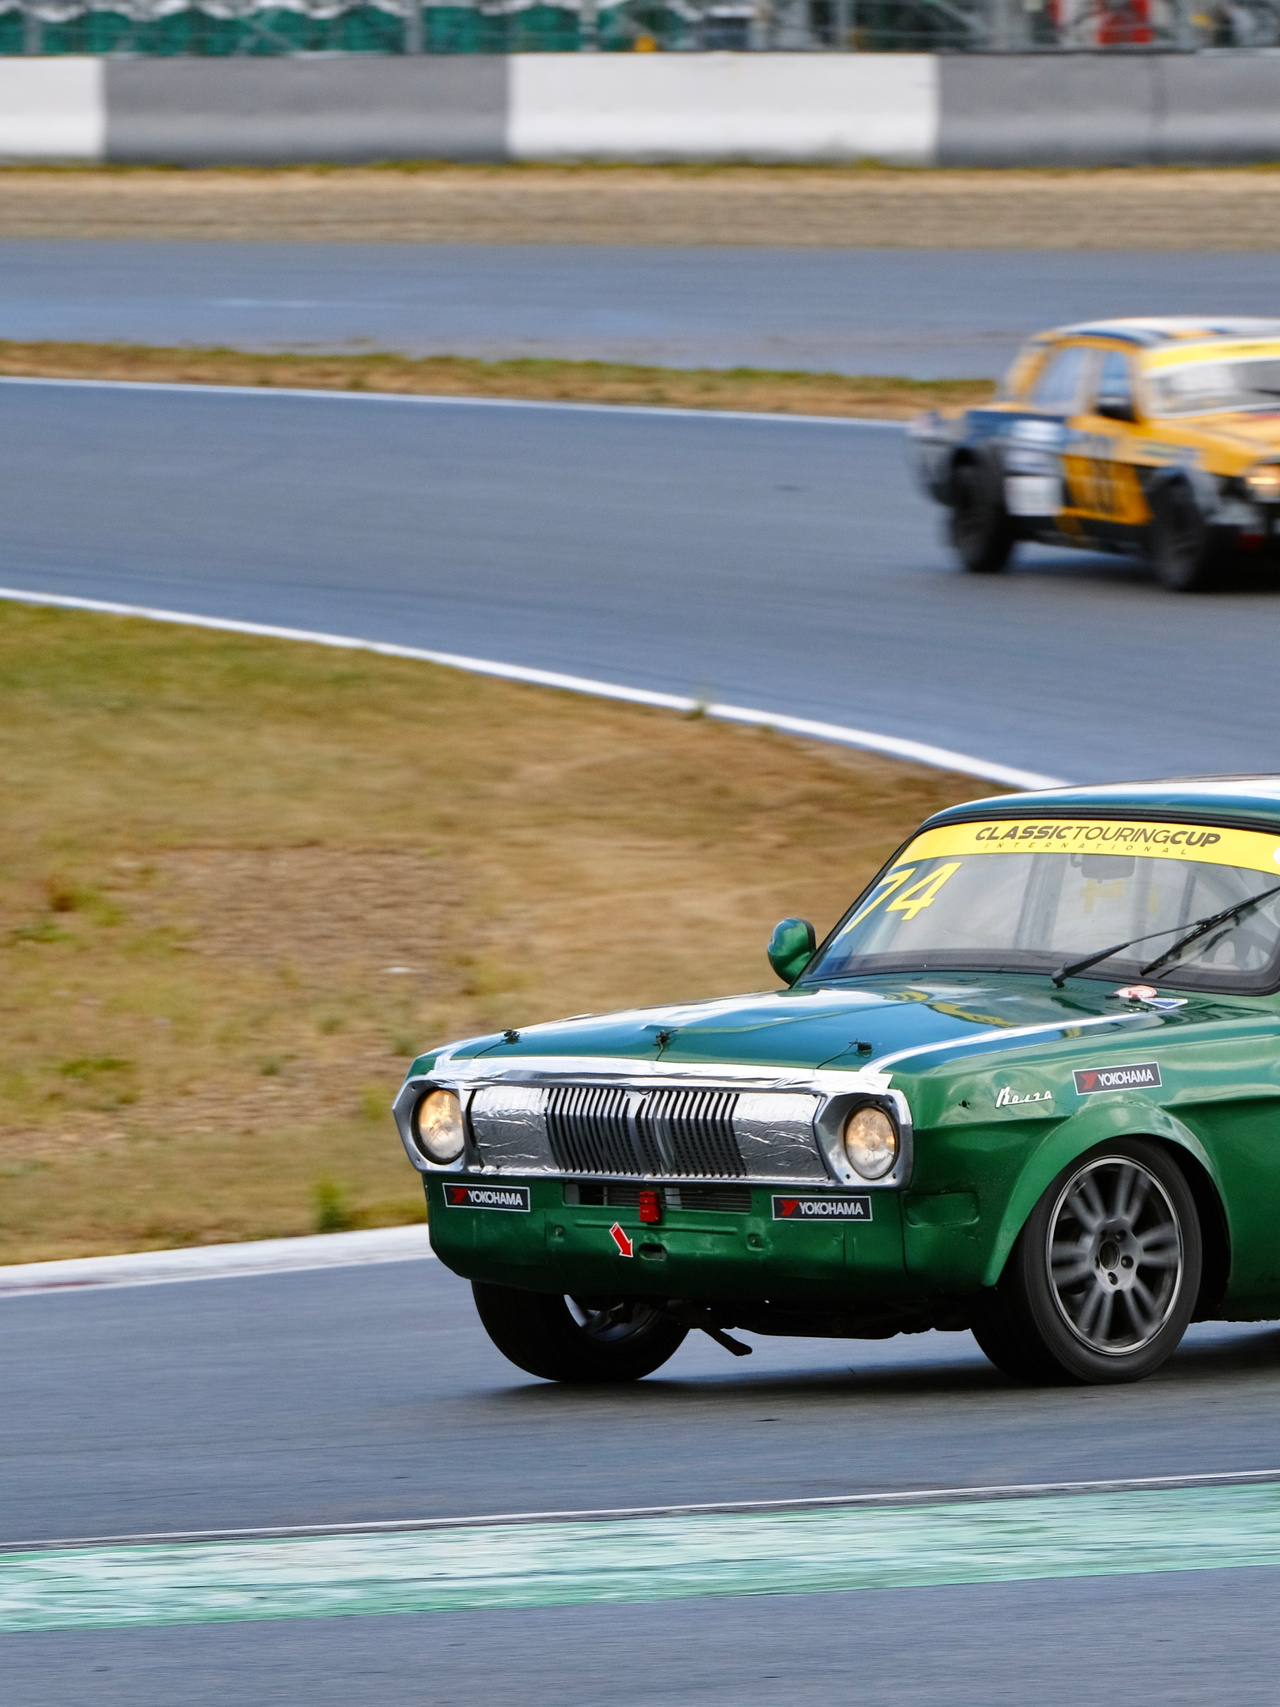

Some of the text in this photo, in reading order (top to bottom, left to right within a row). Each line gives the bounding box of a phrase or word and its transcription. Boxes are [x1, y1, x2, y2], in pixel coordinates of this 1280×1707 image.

[975, 825, 1221, 848] CLASSICTOURINGCUP
[984, 842, 1187, 855] INTERNATIONAL
[843, 862, 962, 935] 74
[1097, 1069, 1155, 1087] YOKOHAMA
[467, 1190, 523, 1206] YOKOHAMA
[798, 1201, 864, 1215] YOKOHAMA
